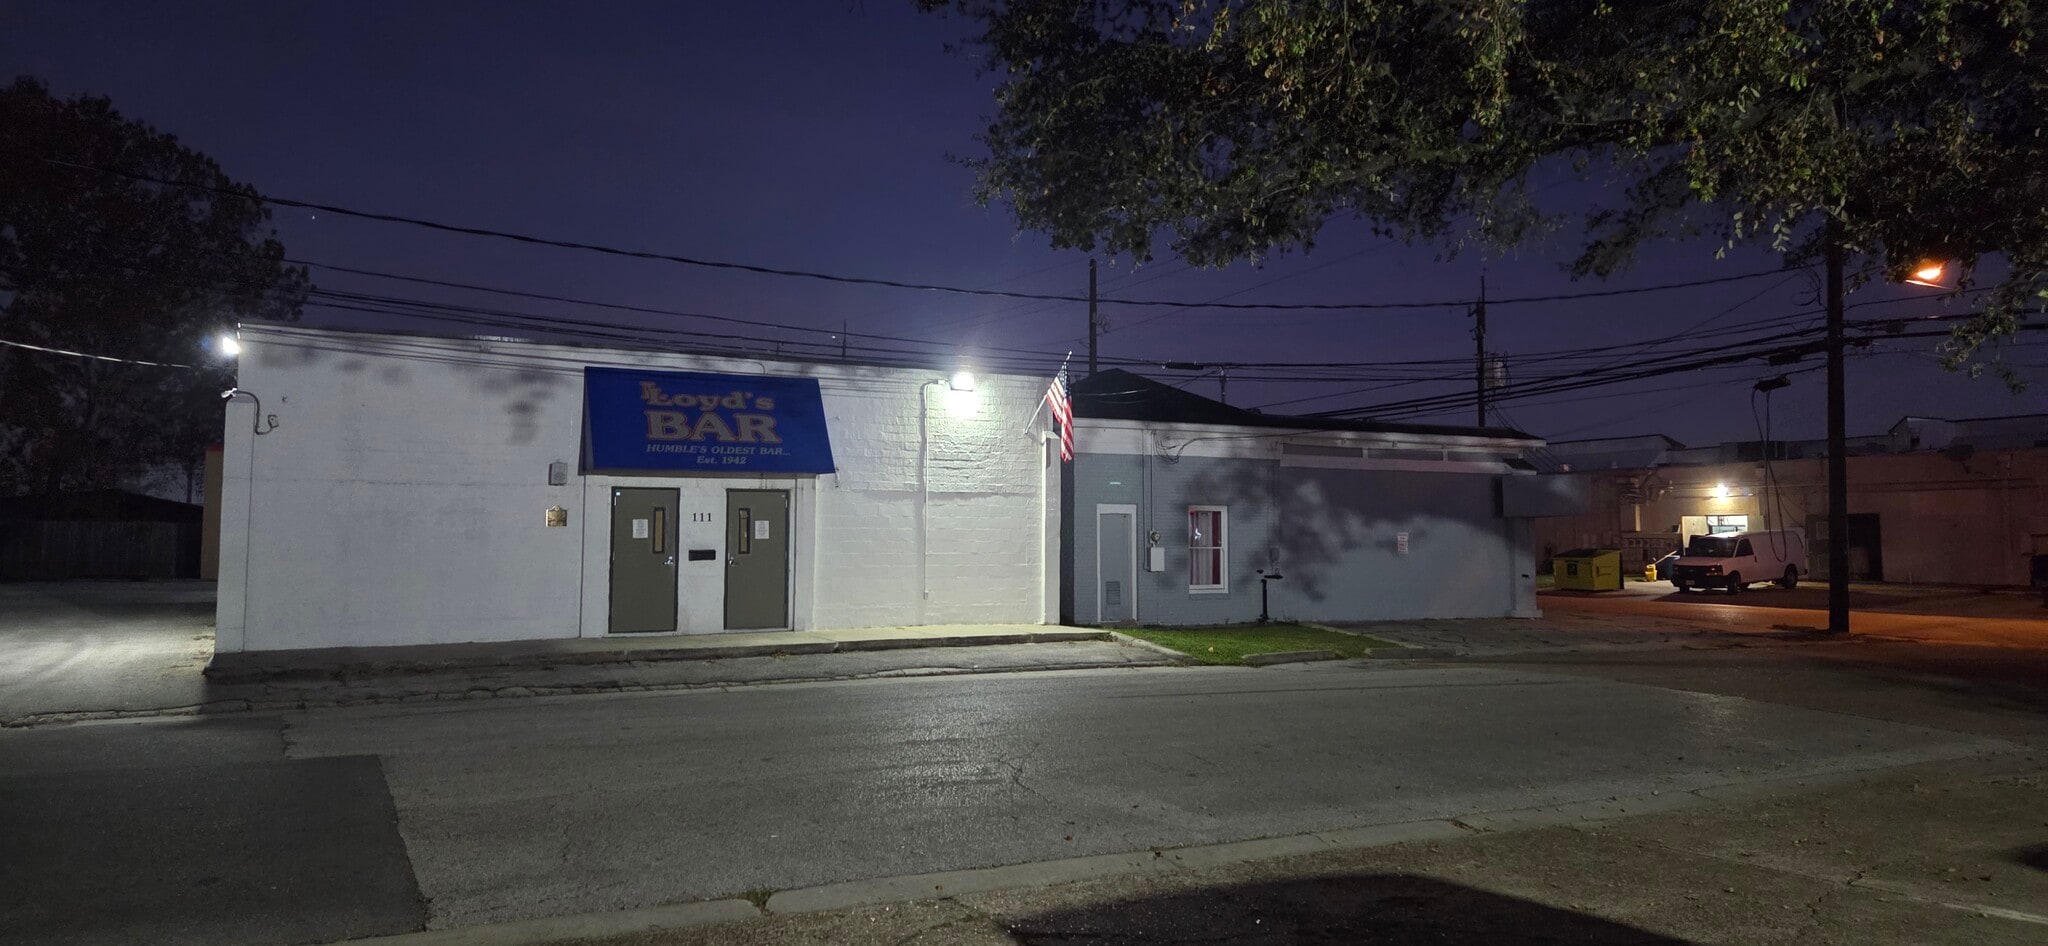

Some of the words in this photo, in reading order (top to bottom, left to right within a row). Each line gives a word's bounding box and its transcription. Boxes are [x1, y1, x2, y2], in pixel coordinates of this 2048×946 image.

[644, 410, 783, 443] BAR
[646, 444, 707, 454] HUMBLE'S
[711, 445, 756, 455] OLDEST
[696, 455, 718, 464] Est.
[721, 456, 747, 465] 1942
[692, 512, 711, 522] 111
